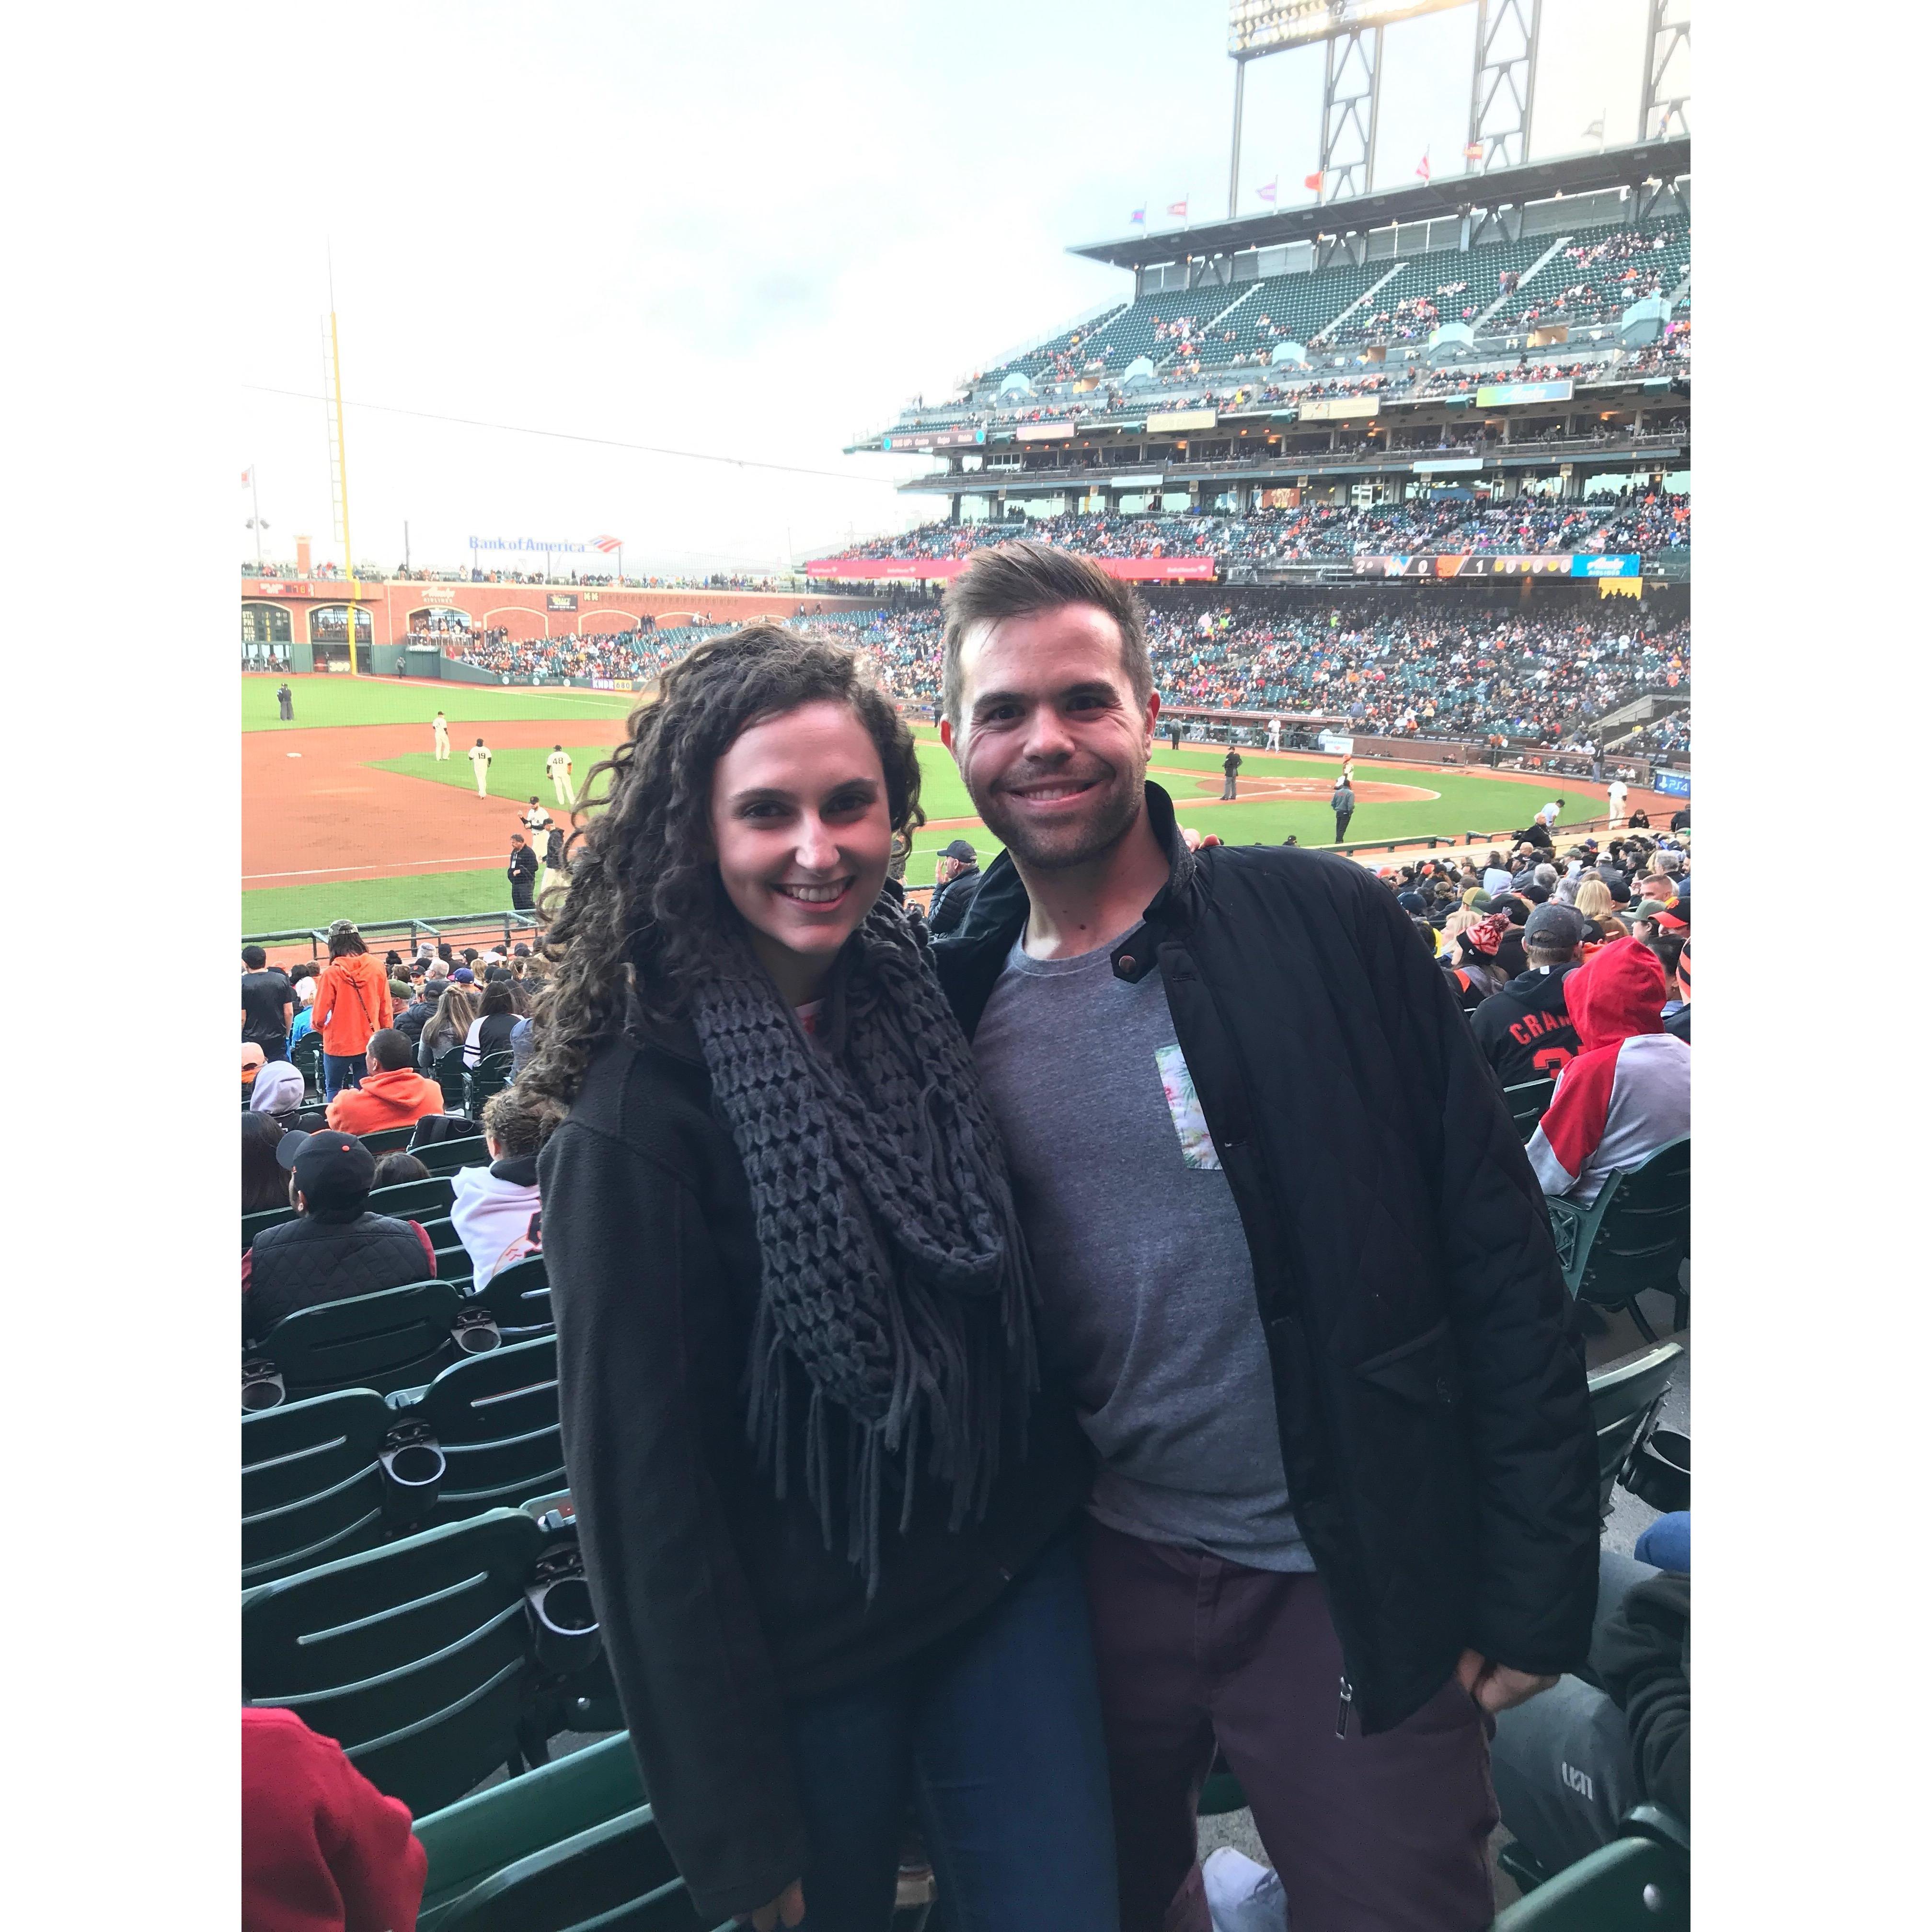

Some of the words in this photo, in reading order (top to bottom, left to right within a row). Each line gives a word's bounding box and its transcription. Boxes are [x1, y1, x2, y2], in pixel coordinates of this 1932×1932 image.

[1501, 385, 1546, 401] Alaska
[469, 536, 506, 550] Bank
[508, 537, 523, 550] of
[526, 538, 585, 552] America
[1357, 560, 1365, 573] 2
[1418, 560, 1428, 574] 0
[1476, 560, 1483, 573] 1
[1587, 557, 1625, 569] Alaska
[329, 662, 350, 672] 309
[593, 679, 614, 689] KNBR
[1669, 779, 1688, 792] PS4
